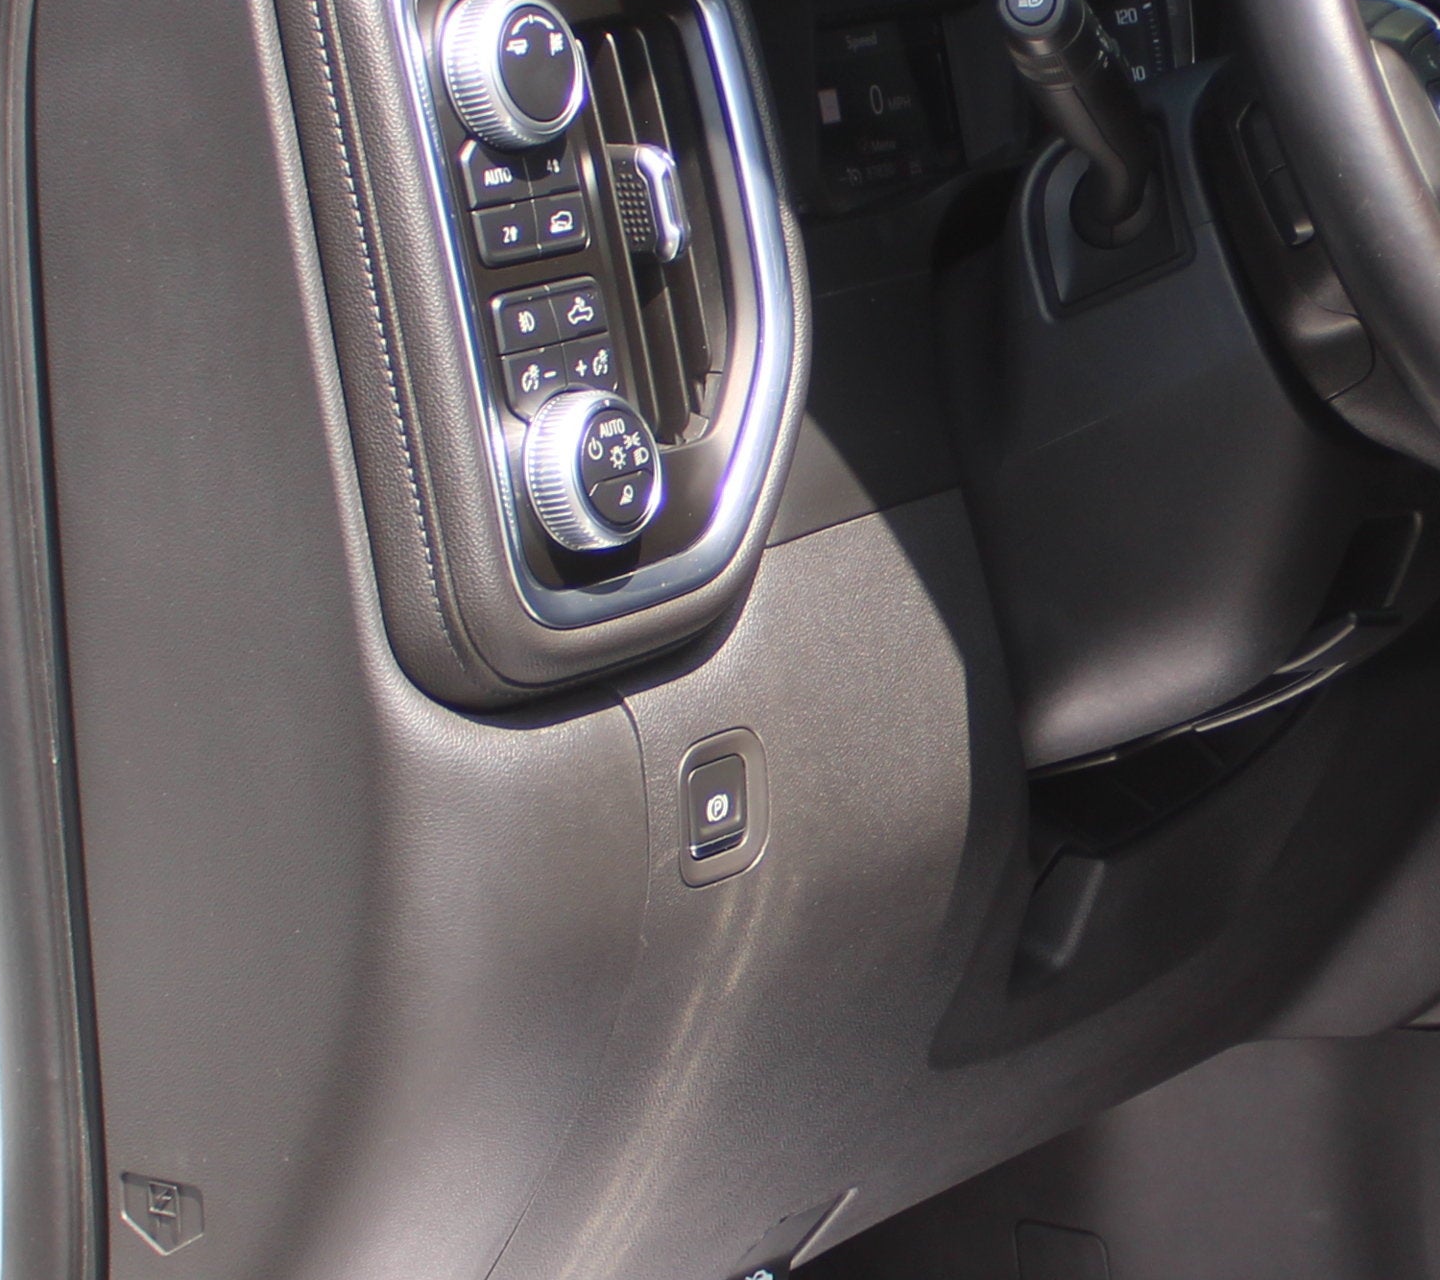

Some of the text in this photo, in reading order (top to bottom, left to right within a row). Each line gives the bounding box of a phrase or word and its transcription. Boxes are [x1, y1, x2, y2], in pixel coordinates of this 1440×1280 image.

[1114, 7, 1138, 26] 120
[869, 84, 884, 115] 0
[483, 166, 512, 186] AUTO
[599, 418, 625, 438] AUTO
